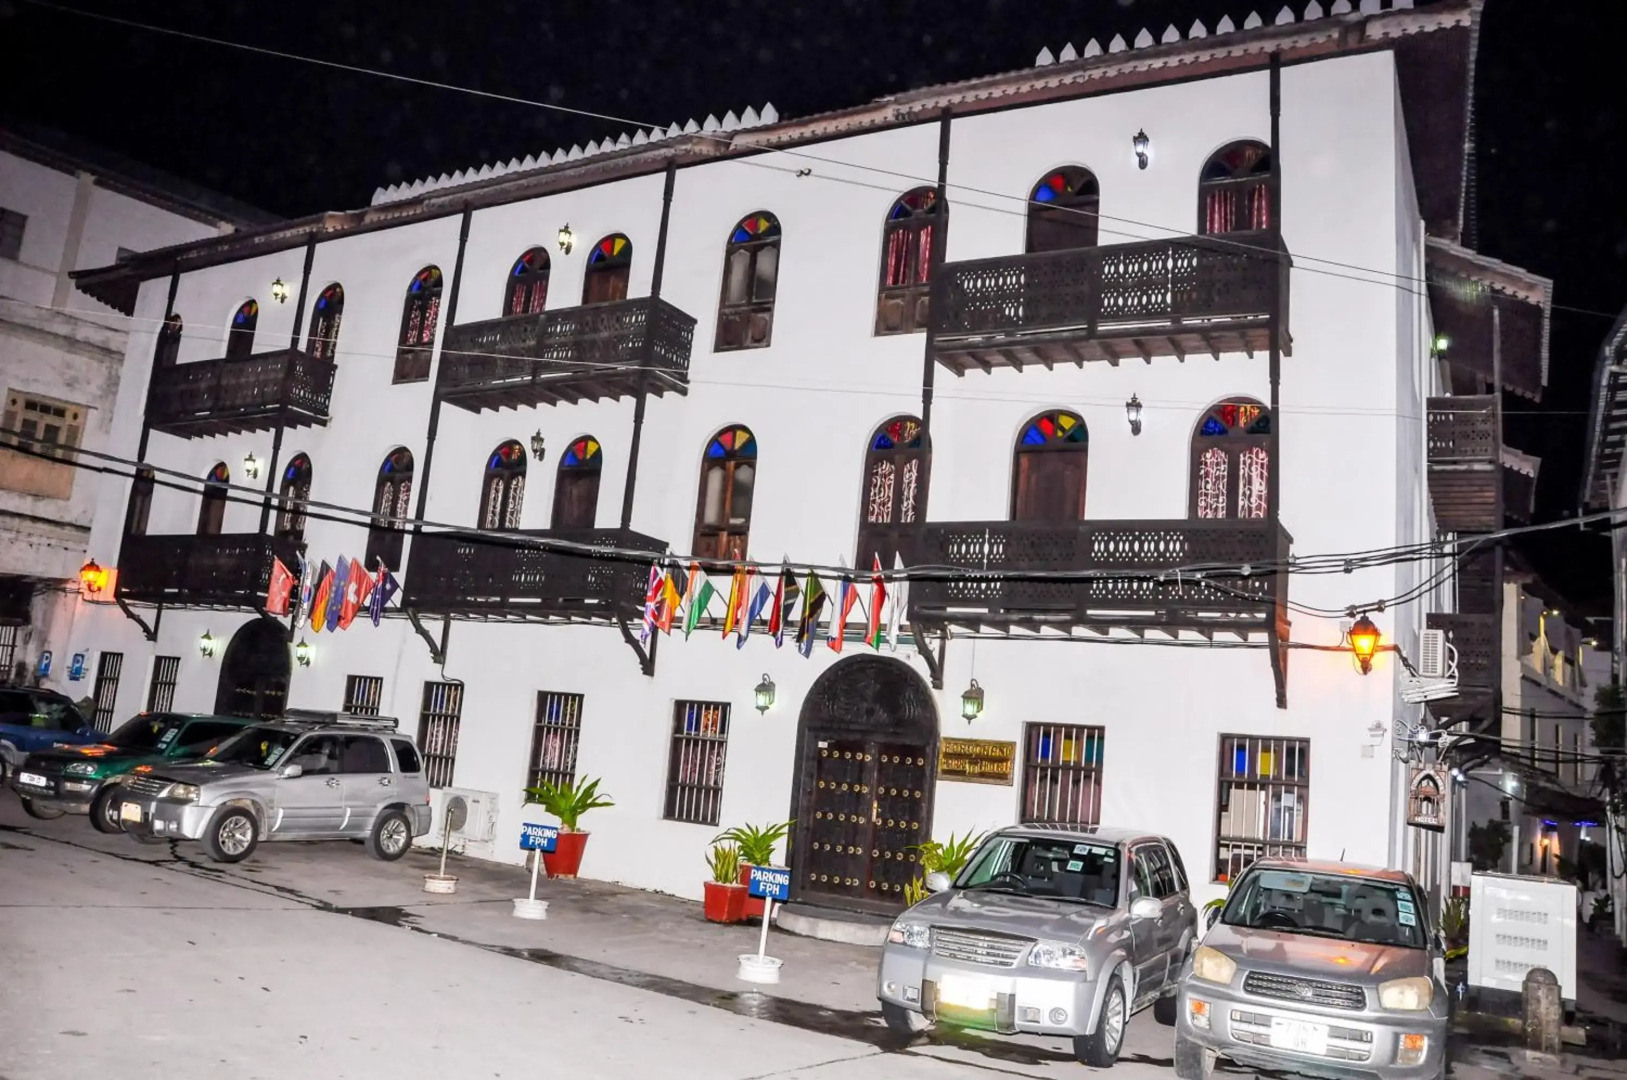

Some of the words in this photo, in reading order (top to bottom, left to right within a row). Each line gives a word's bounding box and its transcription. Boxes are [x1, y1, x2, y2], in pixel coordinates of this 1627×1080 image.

[42, 653, 50, 669] P
[73, 655, 83, 673] P
[1415, 816, 1438, 824] HOTEL
[521, 825, 557, 839] PARKING
[529, 835, 548, 847] FPH
[750, 868, 789, 885] PARKING
[759, 881, 780, 895] FPH
